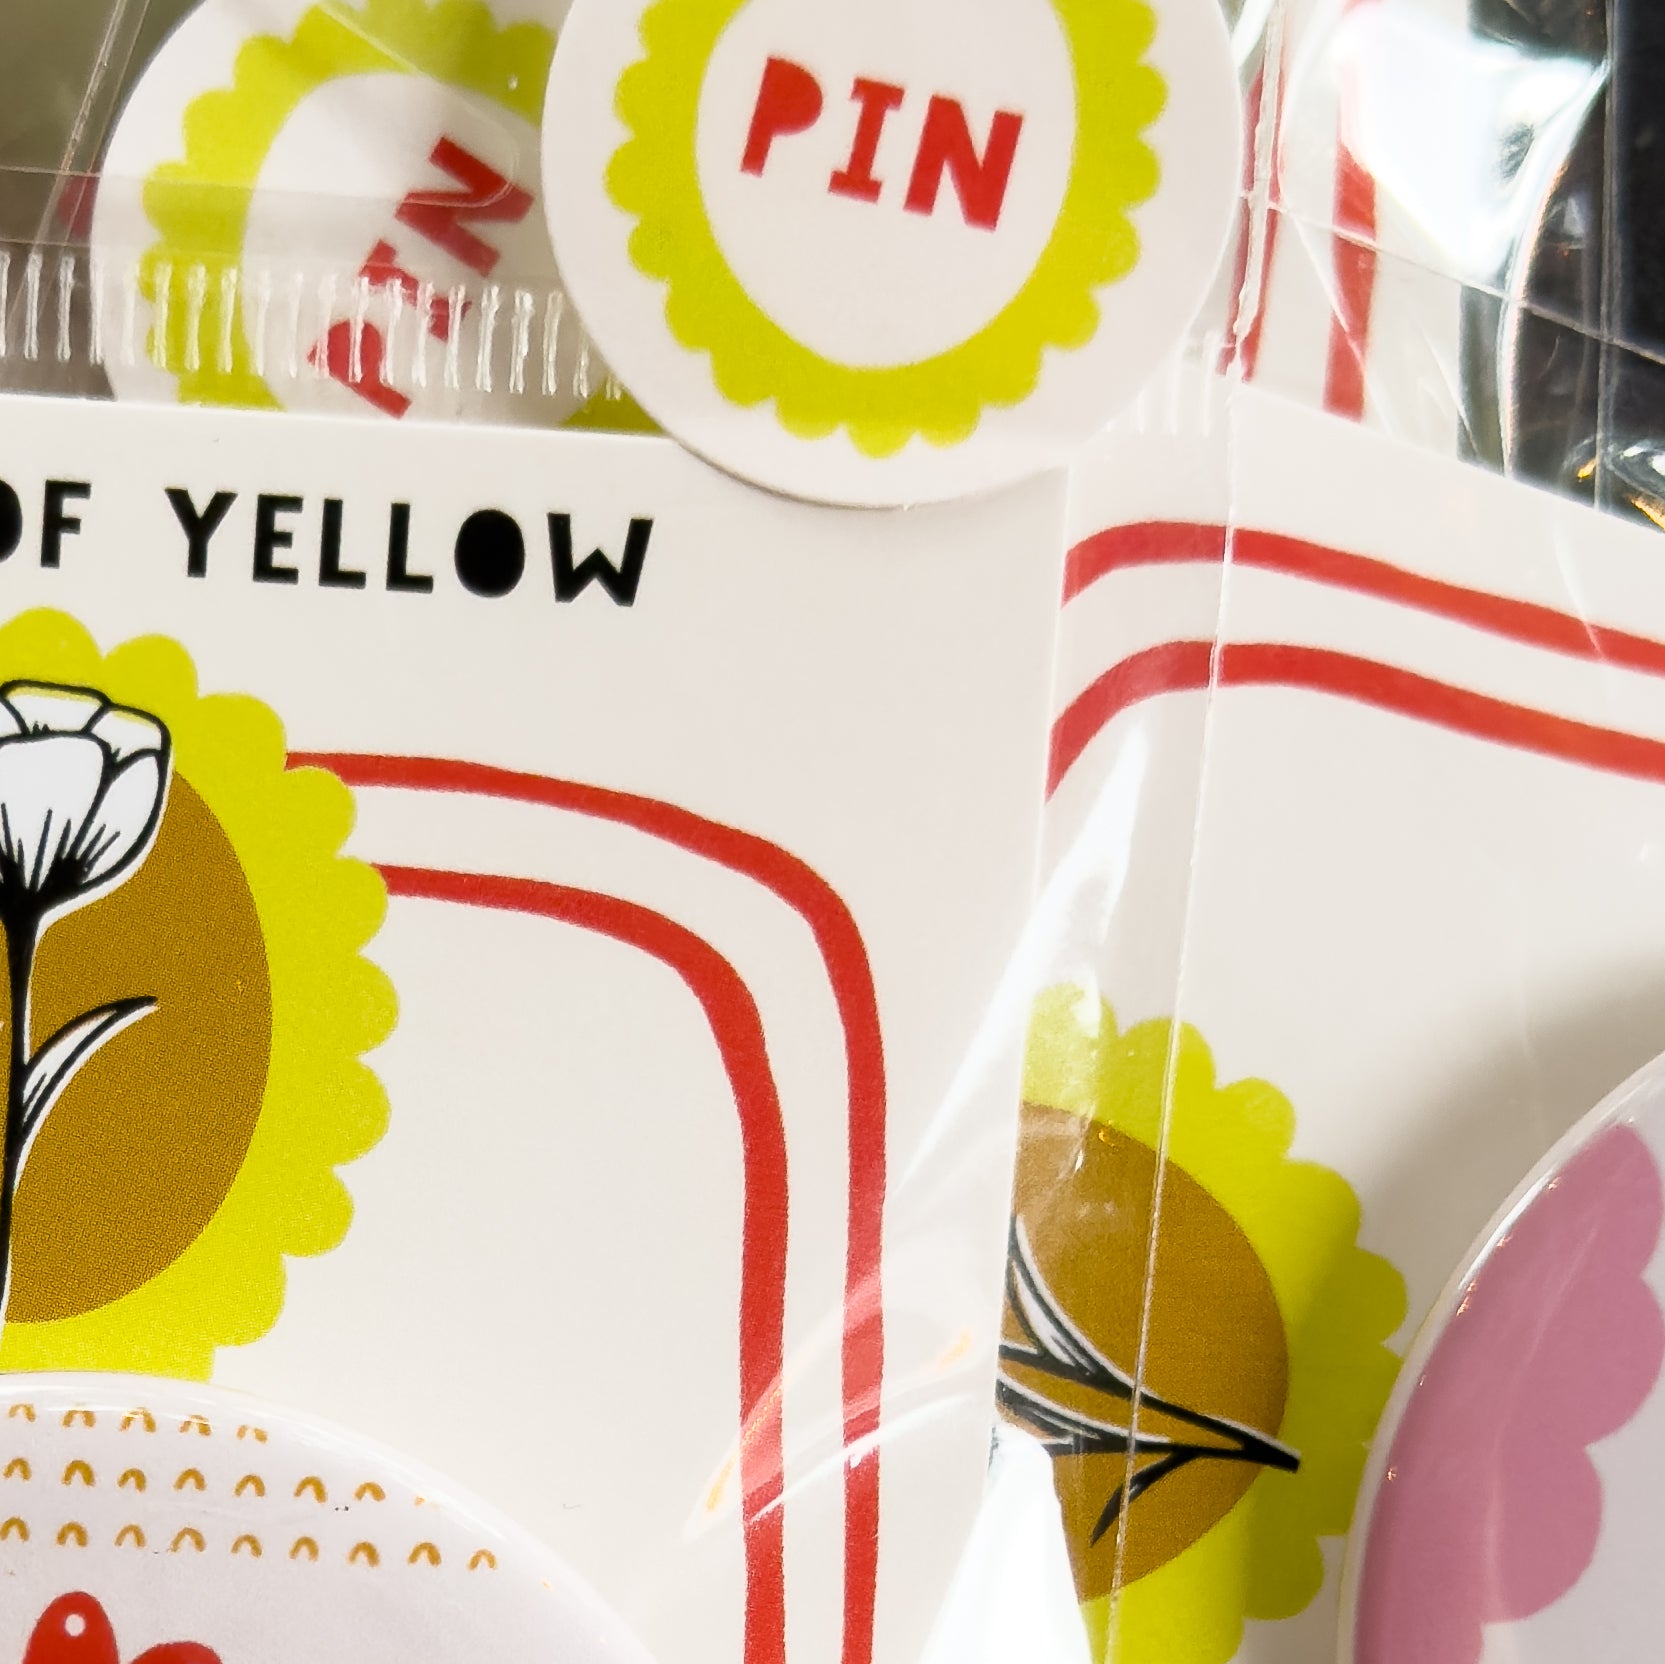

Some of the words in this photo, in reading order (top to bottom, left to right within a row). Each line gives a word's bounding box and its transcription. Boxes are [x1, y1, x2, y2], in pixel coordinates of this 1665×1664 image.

[738, 55, 1024, 232] PIN
[306, 136, 534, 419] PIN
[164, 487, 654, 607] YELLOW
